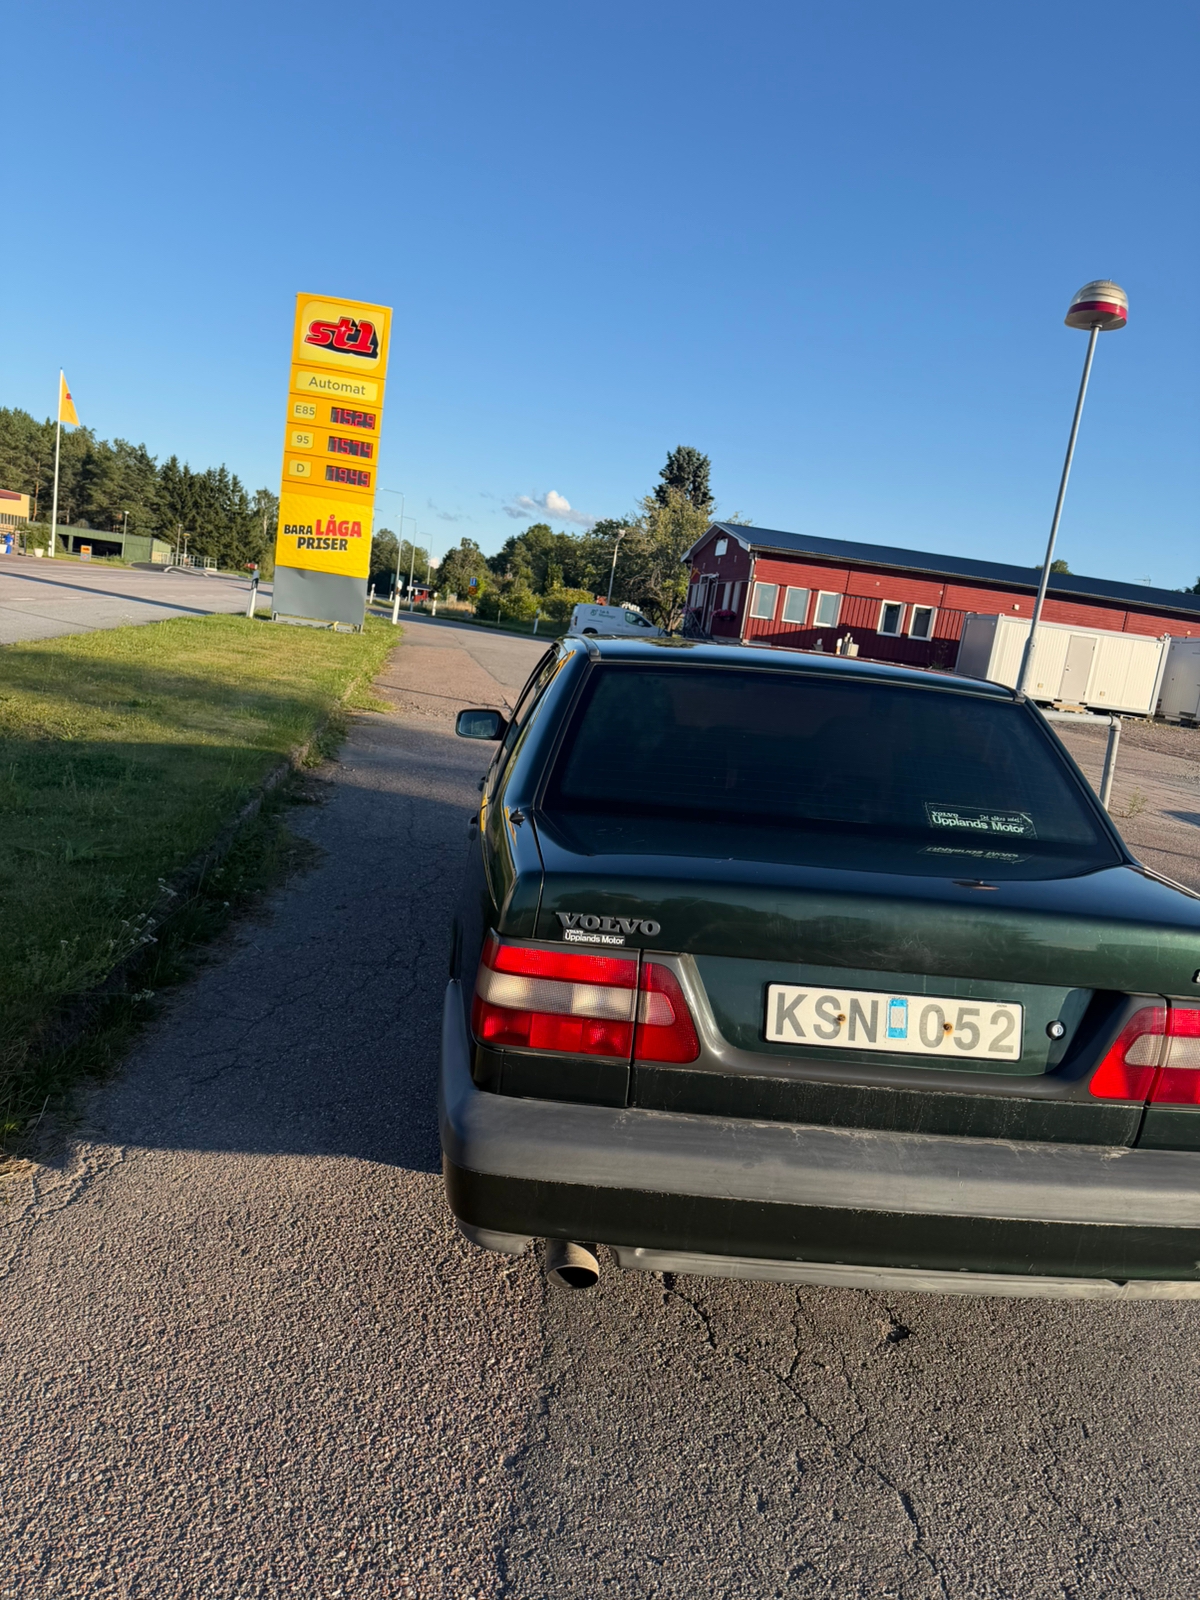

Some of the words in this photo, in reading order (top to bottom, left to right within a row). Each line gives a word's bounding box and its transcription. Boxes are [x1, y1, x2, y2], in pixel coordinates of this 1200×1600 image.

[308, 376, 366, 396] Automat
[295, 404, 315, 416] E85
[296, 434, 310, 445] 95
[296, 463, 305, 473] D
[284, 524, 313, 536] BARA
[315, 514, 362, 538] LÅGA
[297, 537, 348, 551] PRISER
[932, 815, 988, 829] Upplands
[991, 821, 1024, 833] Motor
[556, 911, 661, 936] VOLVO
[565, 932, 600, 943] Upplands
[601, 935, 624, 945] Motor
[775, 992, 879, 1043] KSN
[918, 1003, 1016, 1053] 052
